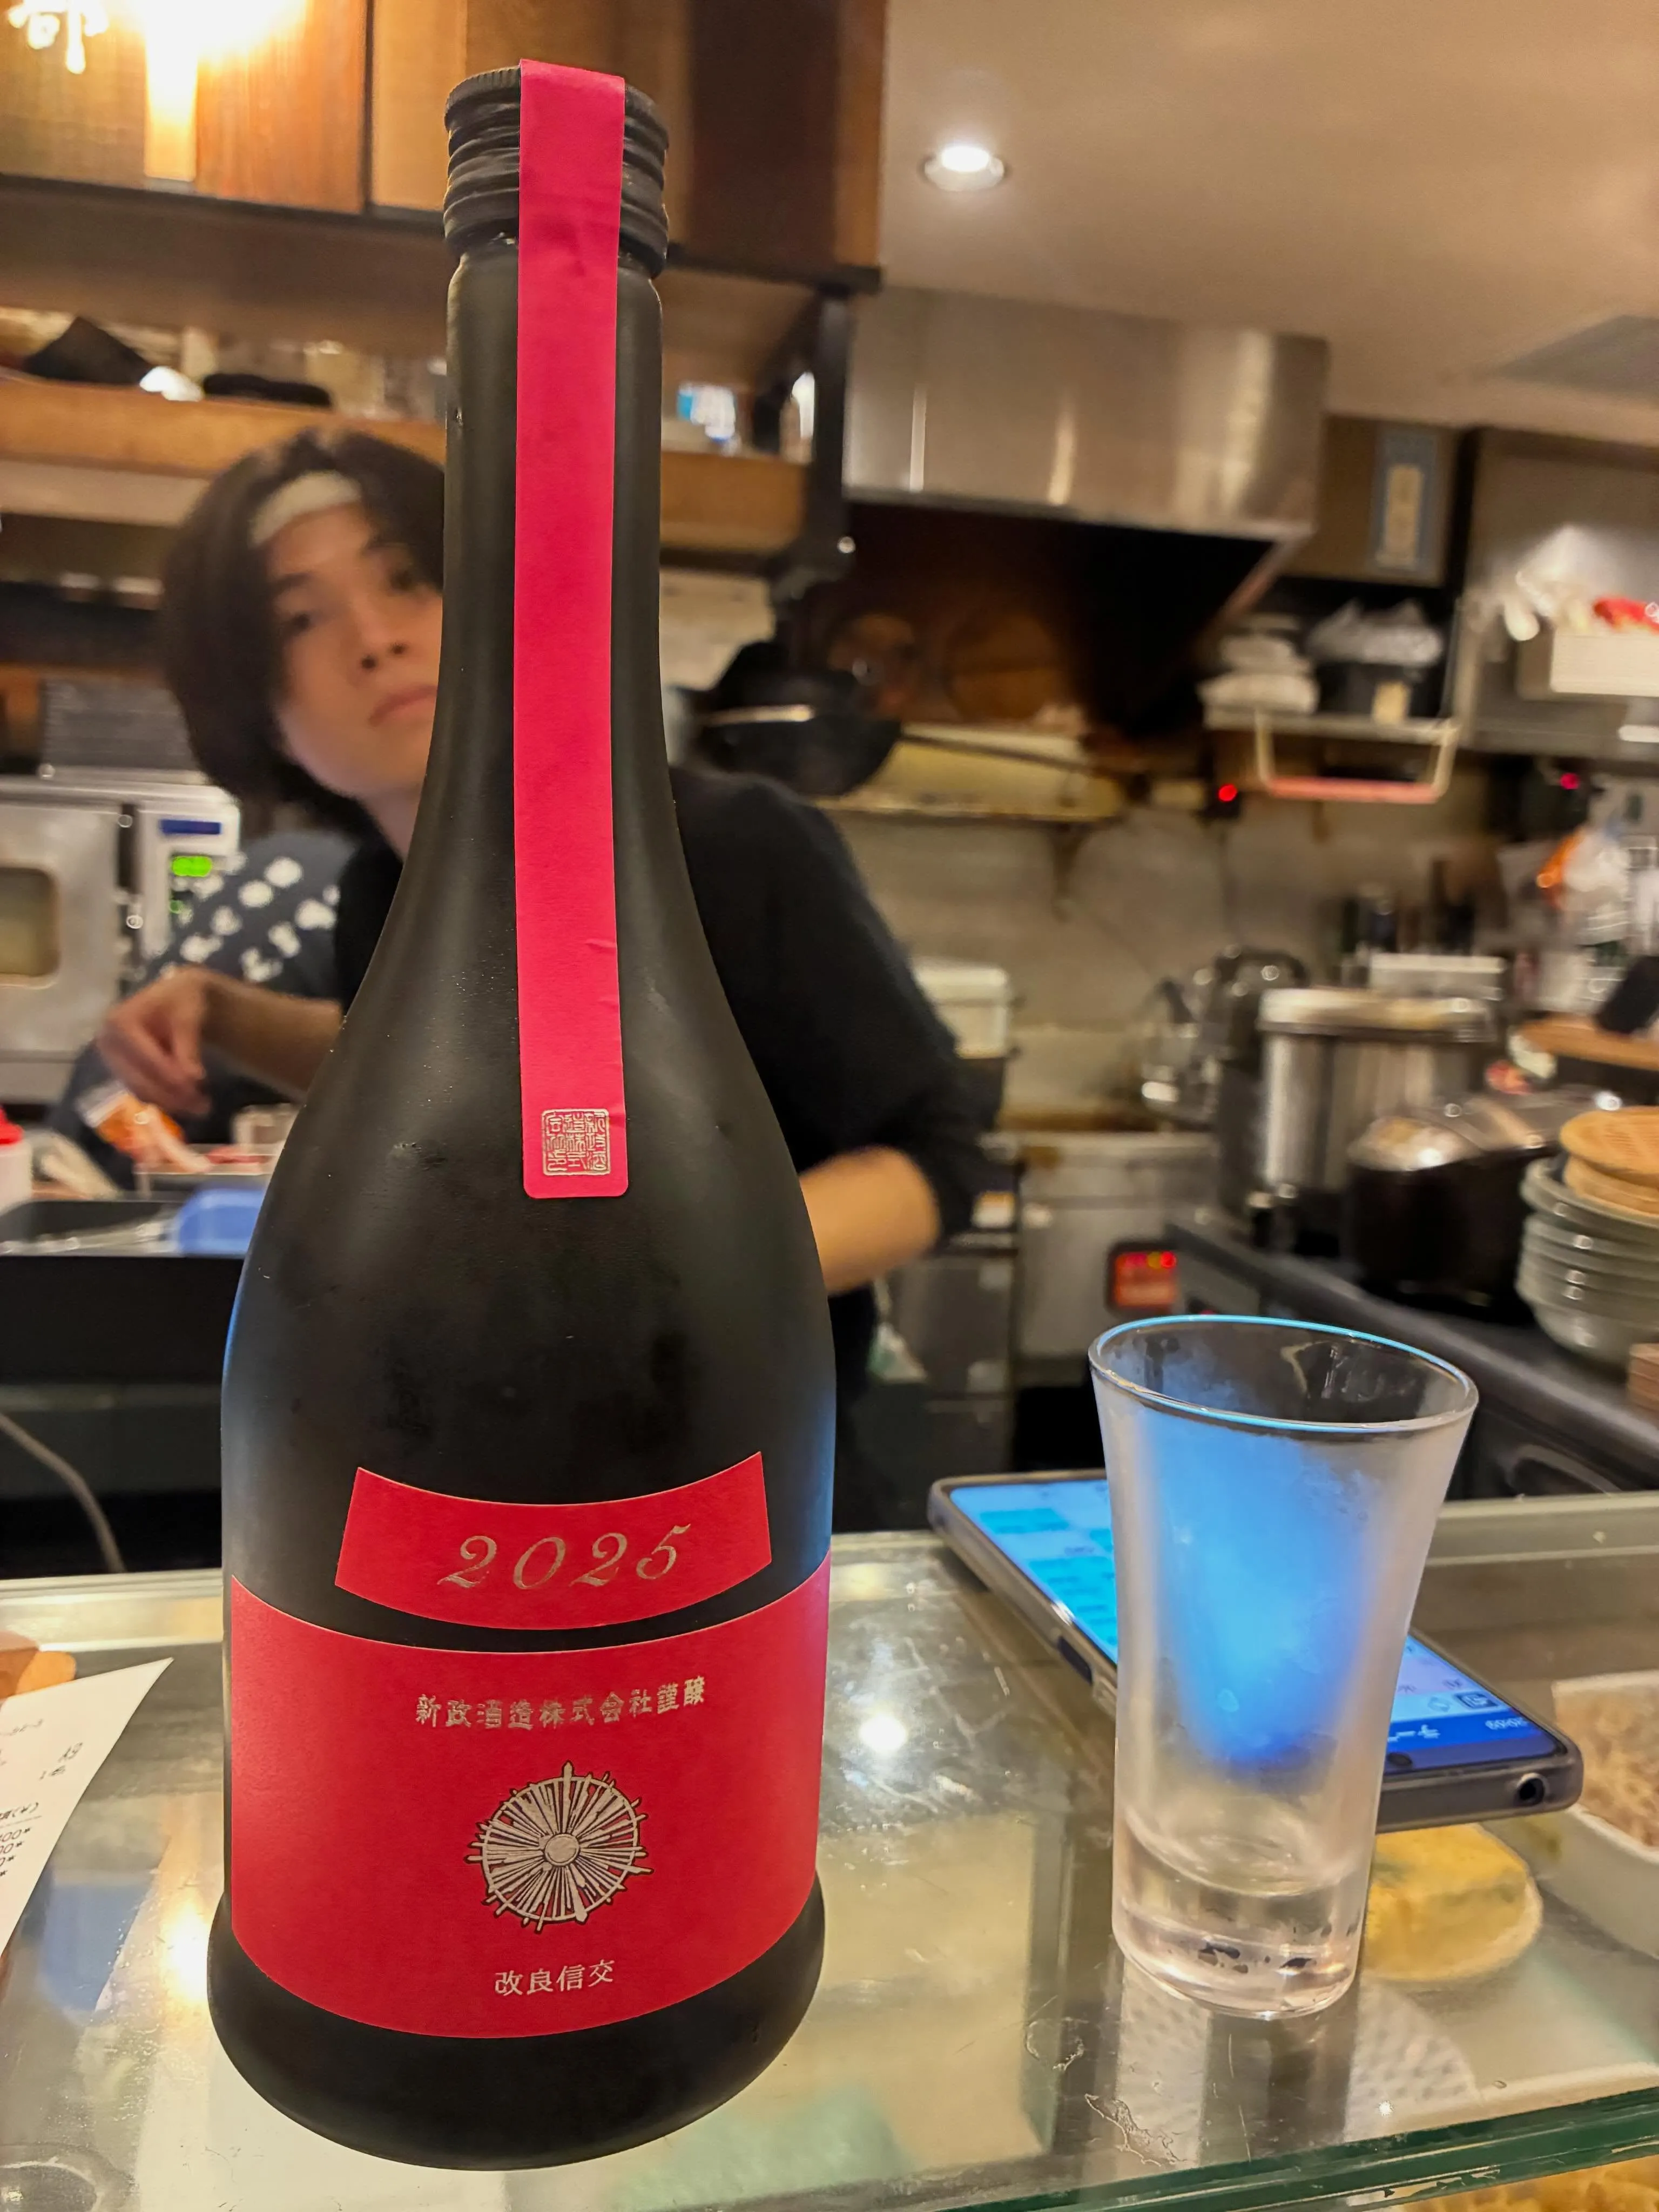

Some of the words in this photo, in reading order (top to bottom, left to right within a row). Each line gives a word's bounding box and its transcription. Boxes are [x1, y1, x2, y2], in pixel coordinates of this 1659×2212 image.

[438, 1523, 690, 1589] 2025
[495, 1959, 615, 1996] 改良信交
